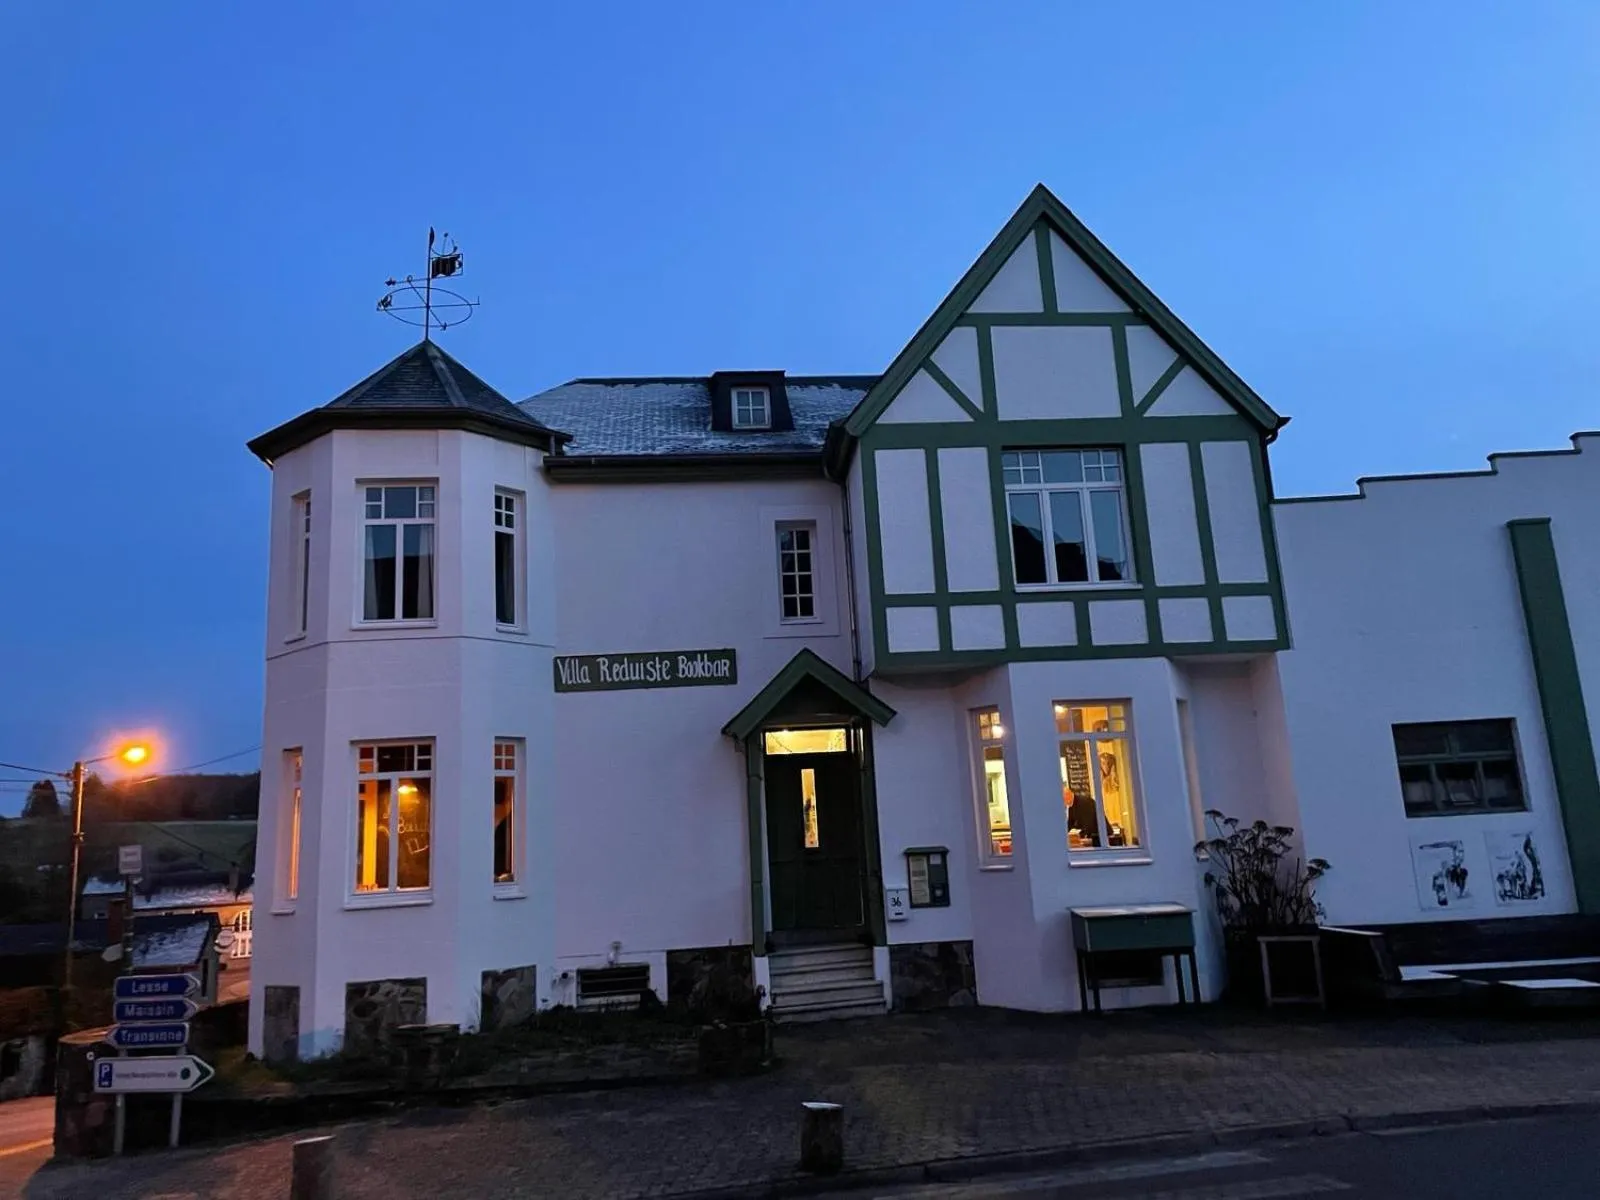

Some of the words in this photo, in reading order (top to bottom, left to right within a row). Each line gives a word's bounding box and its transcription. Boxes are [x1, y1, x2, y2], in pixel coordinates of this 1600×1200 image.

[557, 658, 591, 685] Villa
[596, 656, 671, 682] Reduiste
[891, 897, 902, 907] 36
[132, 980, 169, 994] Lesse
[124, 1004, 175, 1017] Maissin
[121, 1029, 182, 1042] Transinne
[102, 1065, 110, 1078] P
